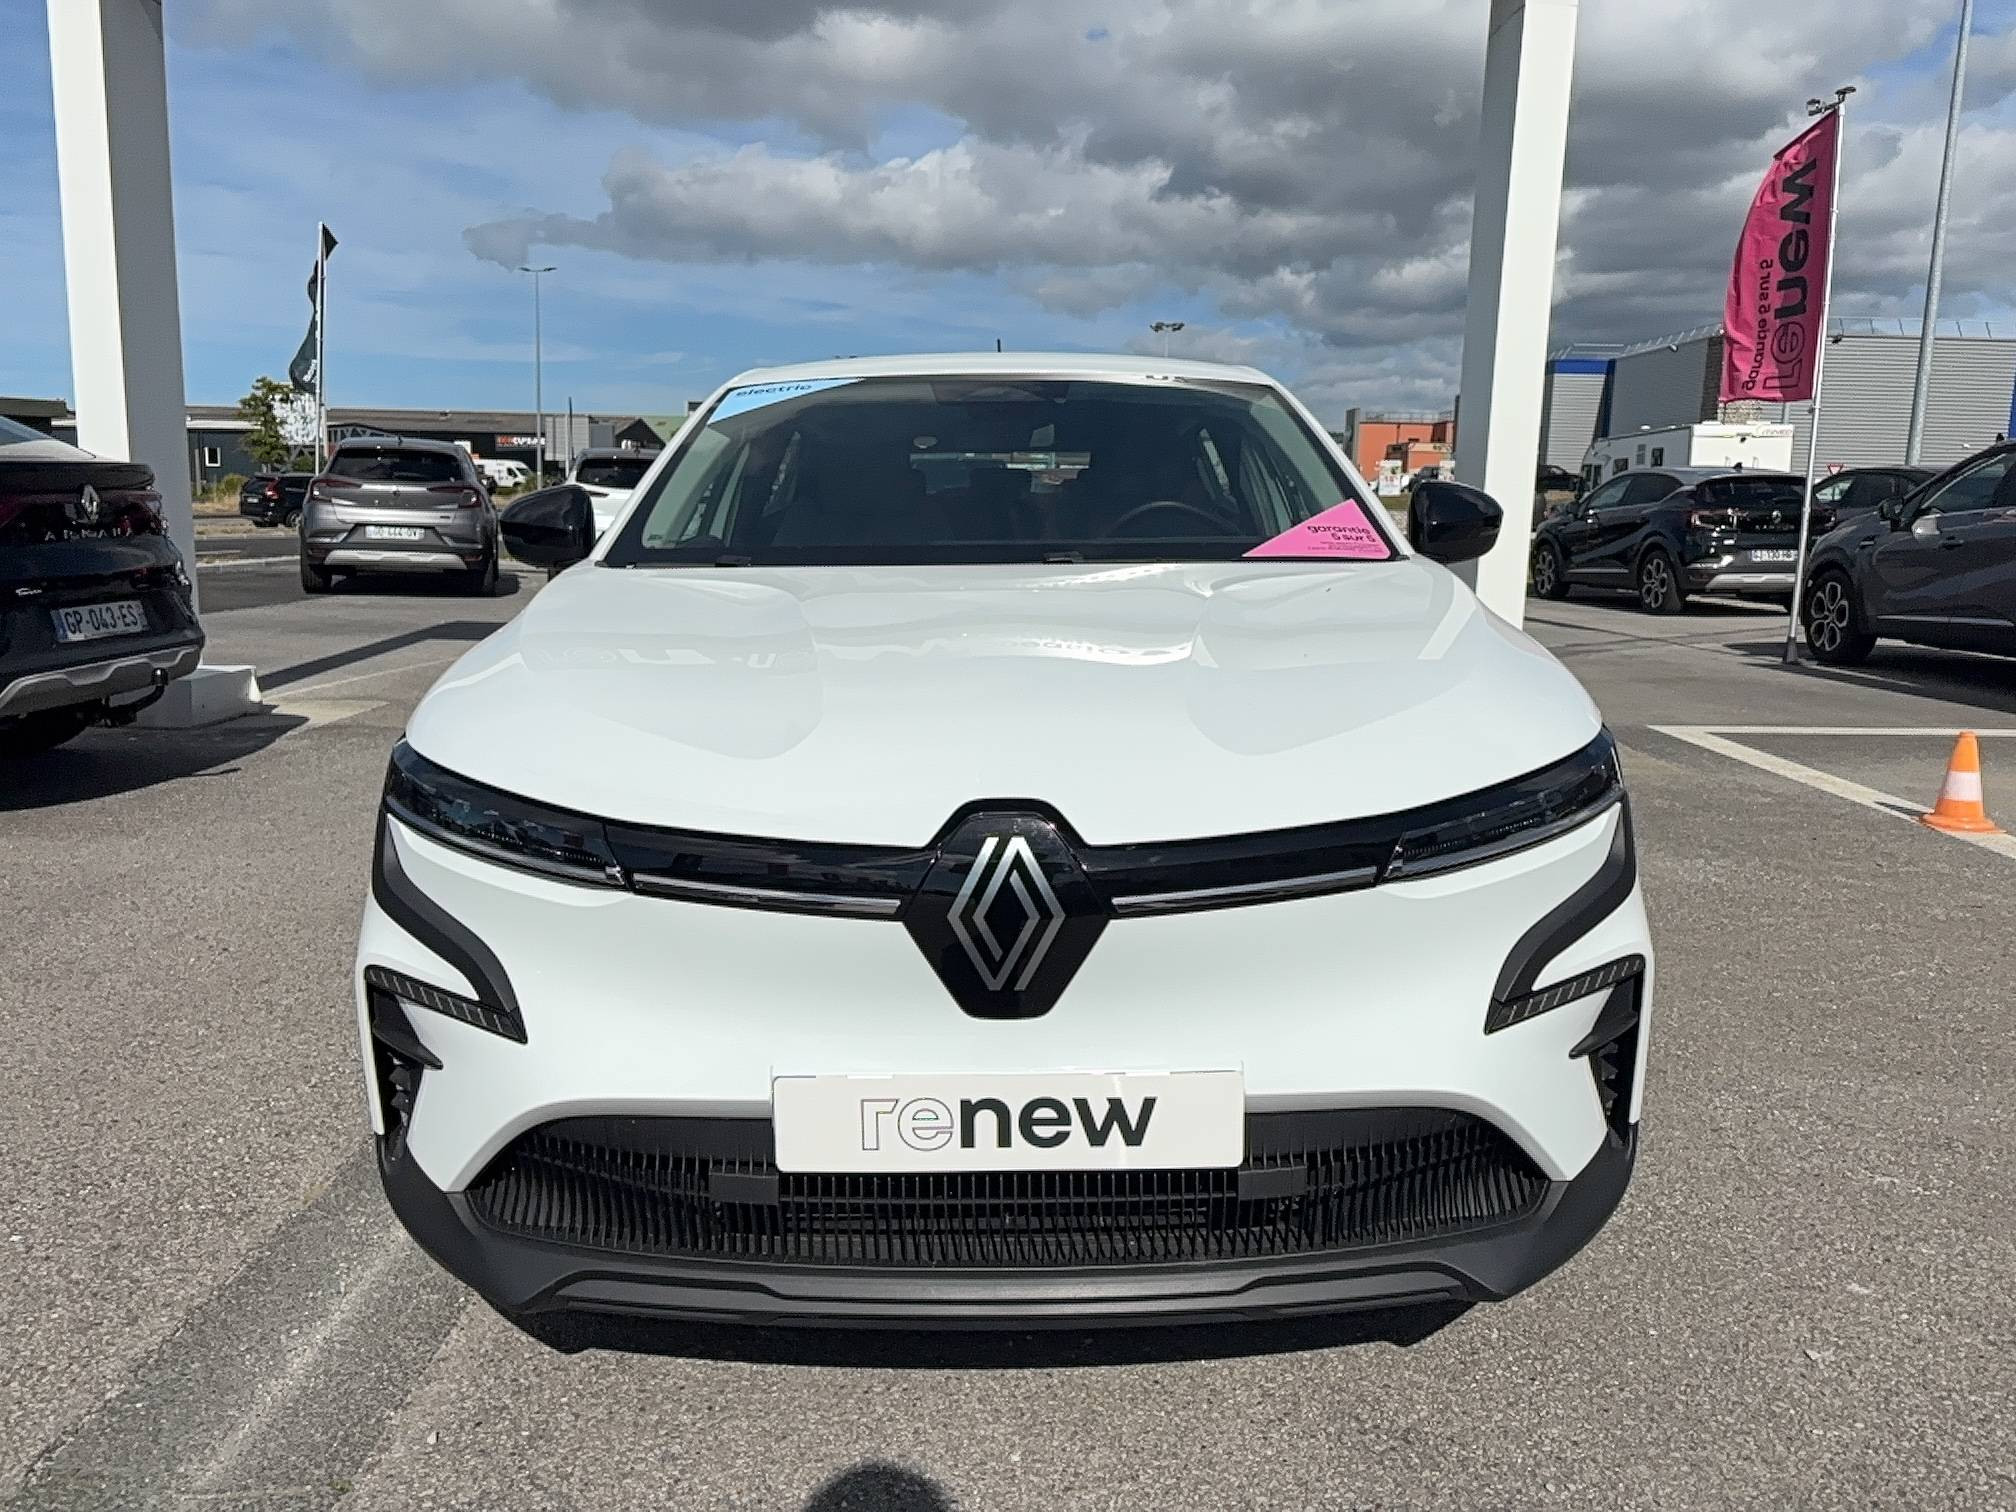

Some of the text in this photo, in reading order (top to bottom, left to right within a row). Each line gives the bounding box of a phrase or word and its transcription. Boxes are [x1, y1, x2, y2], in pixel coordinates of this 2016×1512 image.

[1307, 525, 1371, 535] garantie
[64, 603, 138, 634] GP-043-ES
[860, 1096, 1158, 1151] renew
